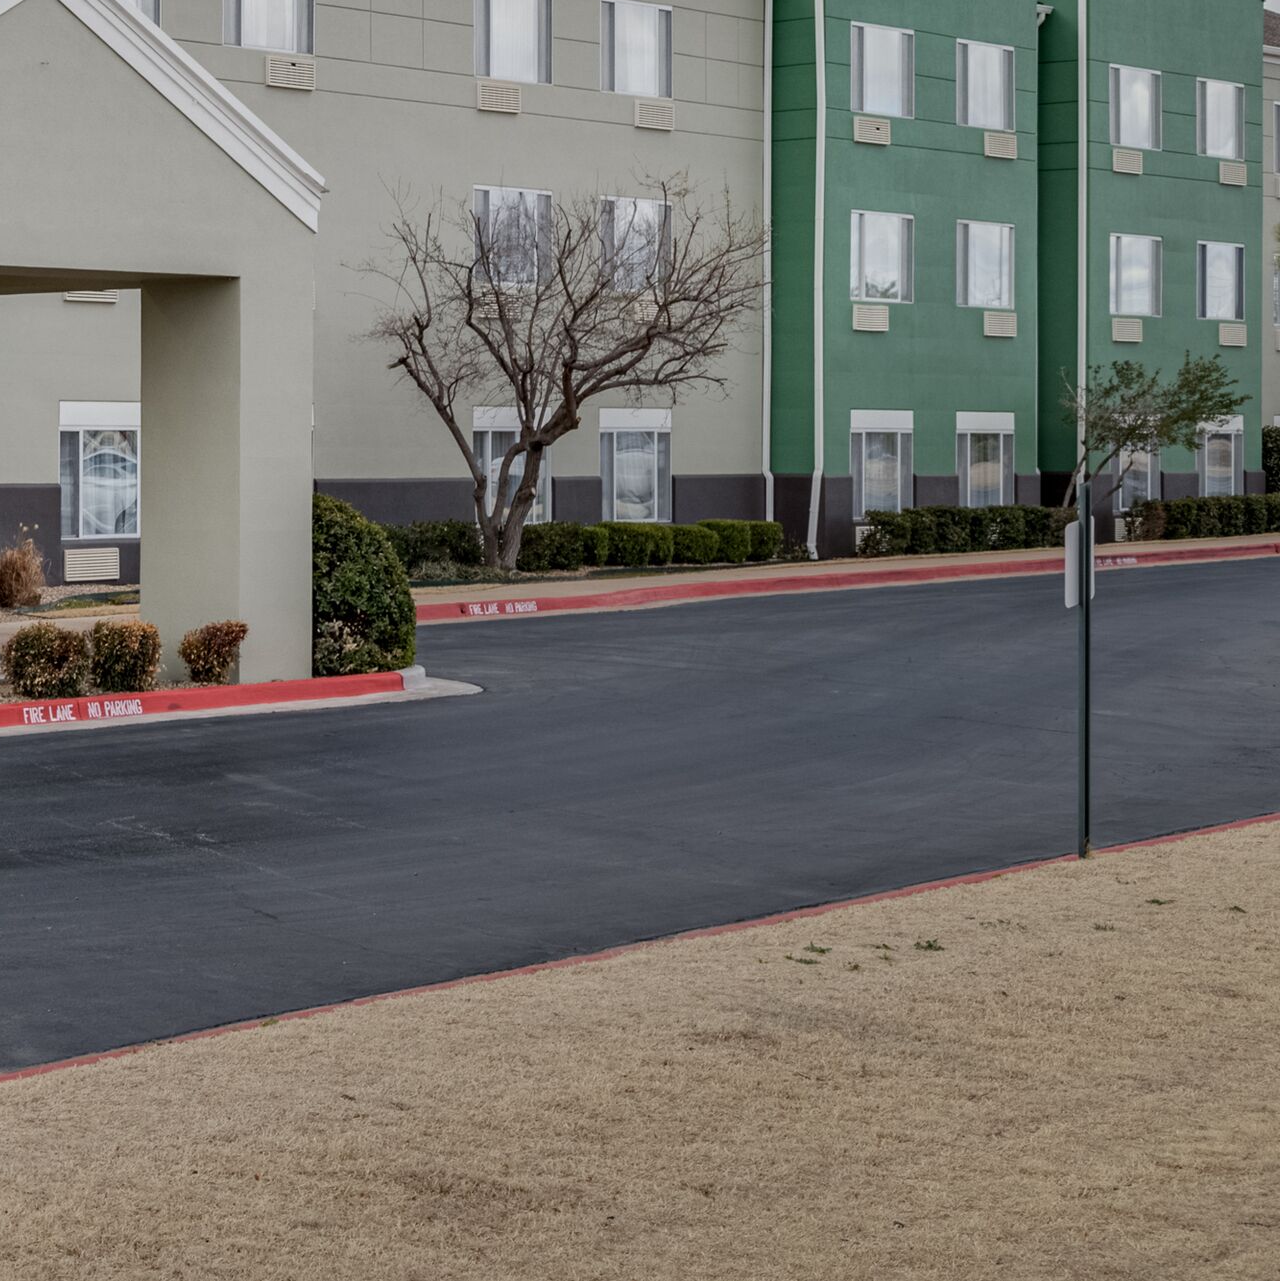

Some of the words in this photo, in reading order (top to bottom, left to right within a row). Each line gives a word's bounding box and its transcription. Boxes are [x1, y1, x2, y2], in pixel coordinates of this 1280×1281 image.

[23, 706, 47, 724] FIRE
[49, 704, 76, 721] LANE
[88, 701, 102, 718] NO
[104, 699, 143, 717] PARKING
